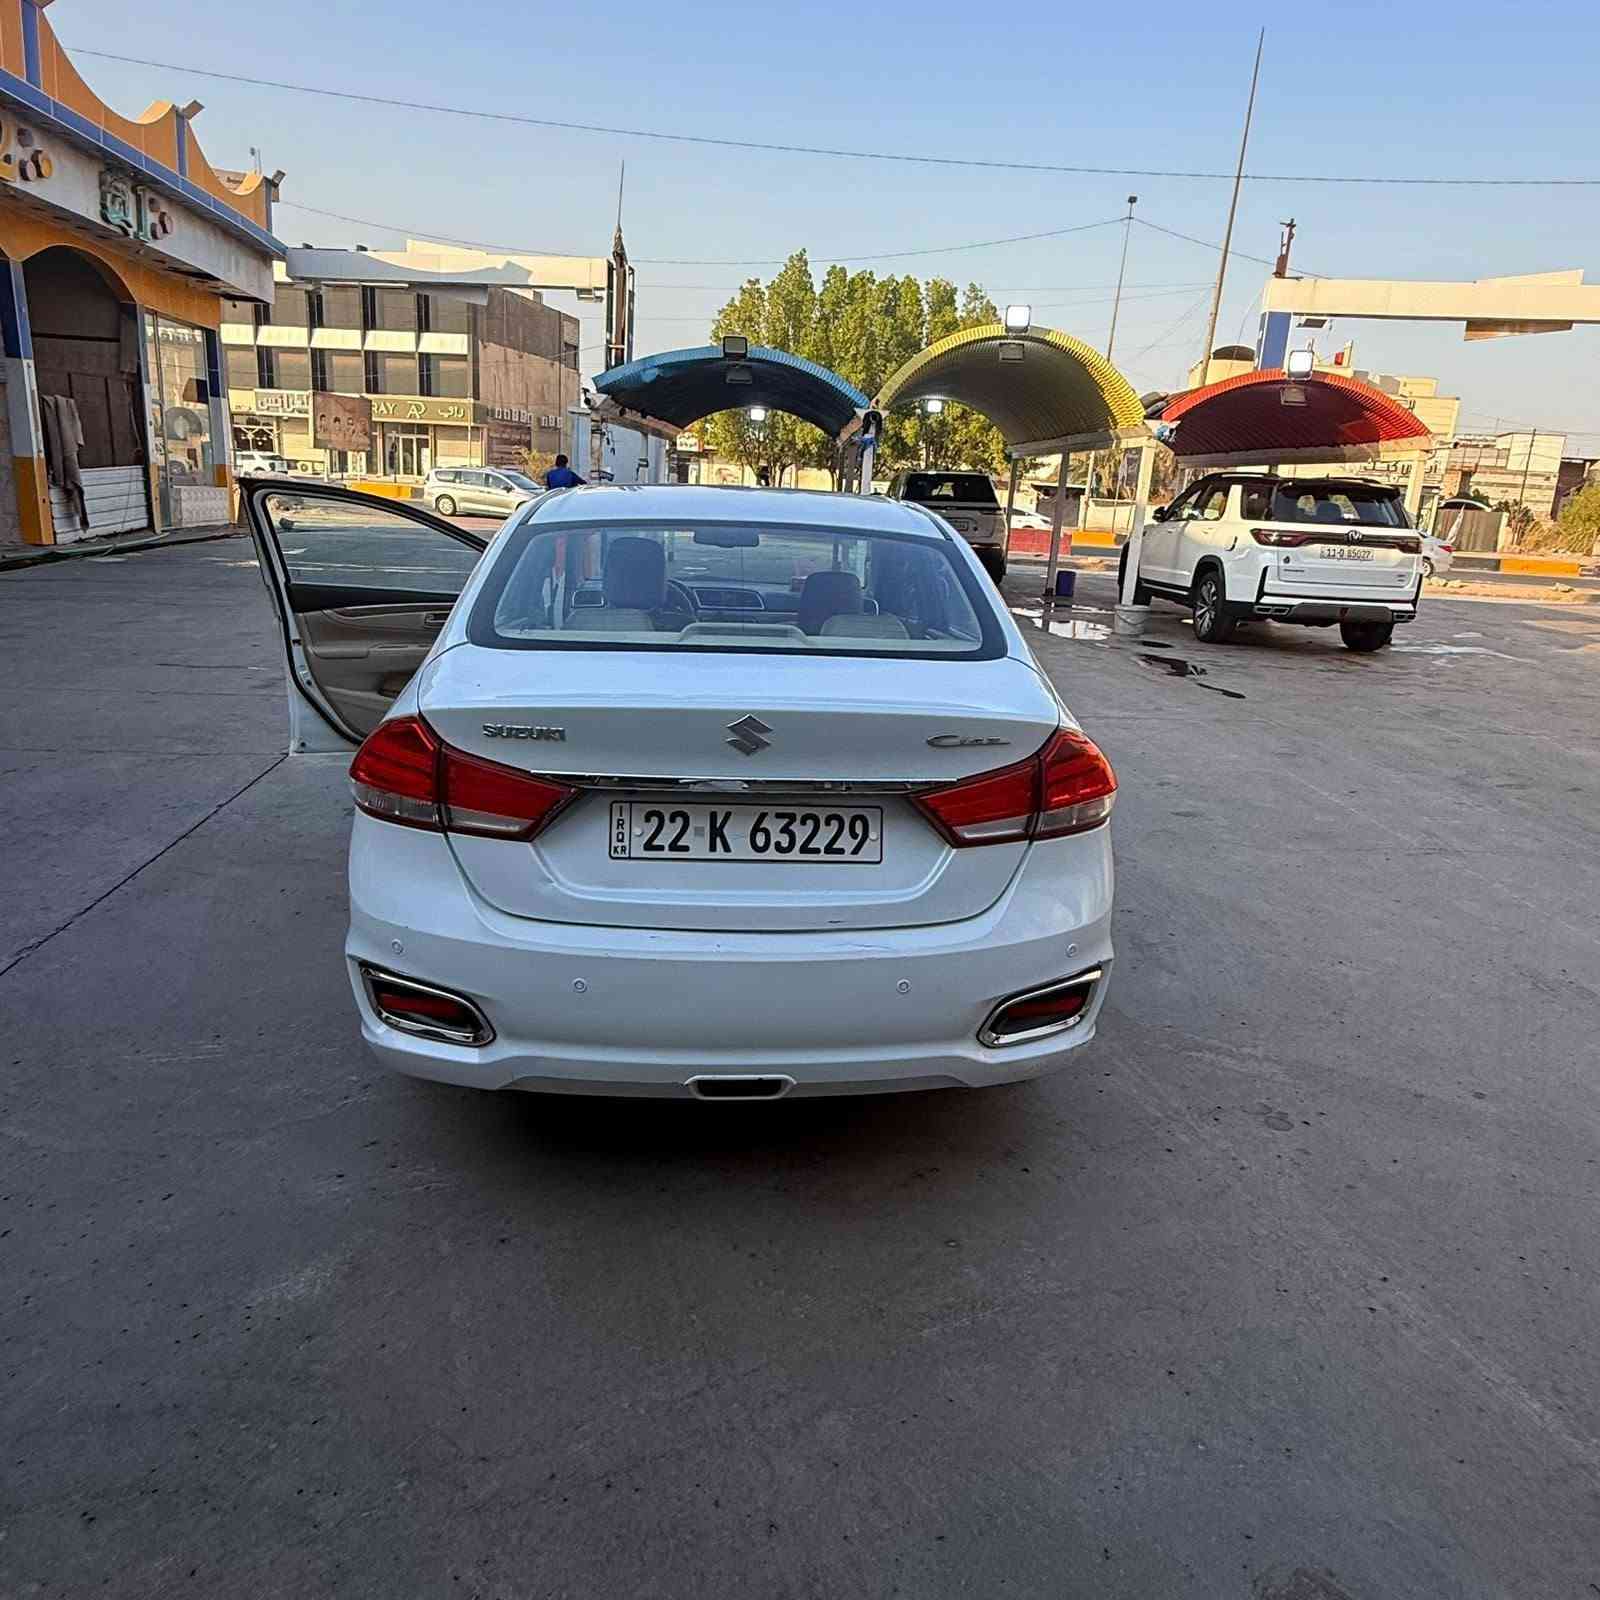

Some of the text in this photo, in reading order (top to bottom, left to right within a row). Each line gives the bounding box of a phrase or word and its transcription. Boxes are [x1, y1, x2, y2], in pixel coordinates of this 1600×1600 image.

[482, 722, 566, 742] SUZUKI
[615, 804, 625, 844] IRQ
[643, 809, 870, 855] 22 K 63229
[613, 845, 627, 855] KR
